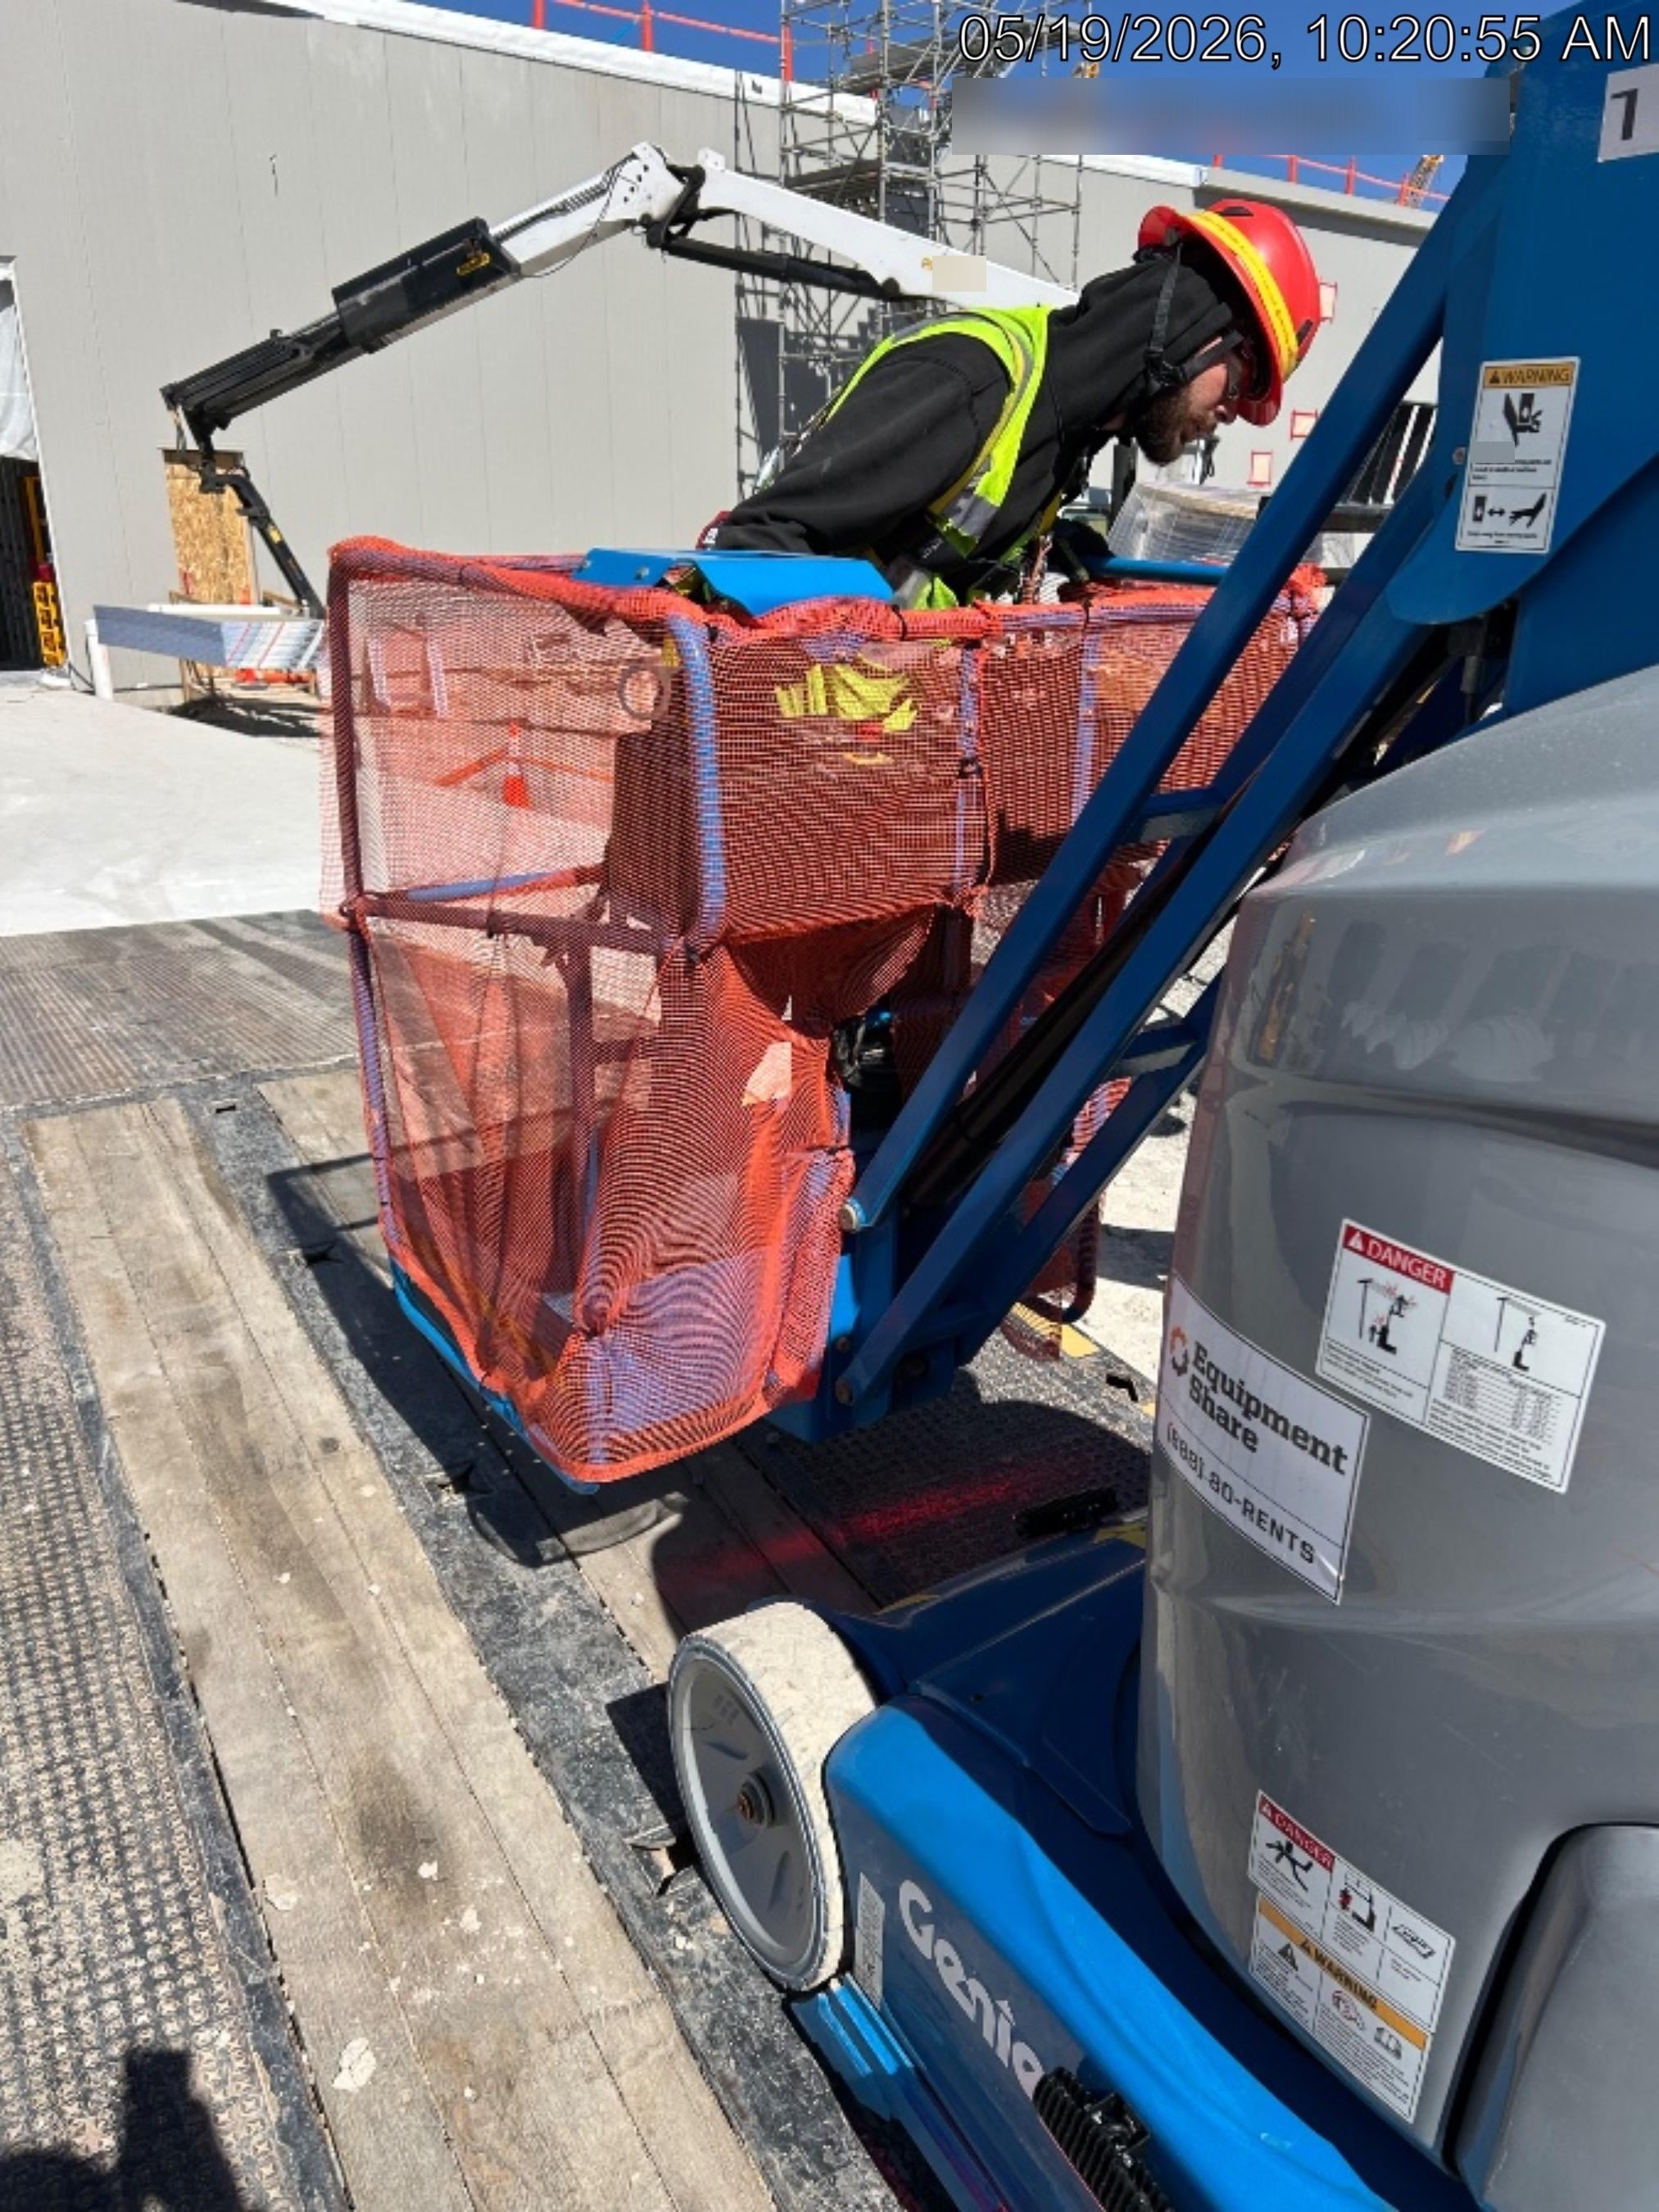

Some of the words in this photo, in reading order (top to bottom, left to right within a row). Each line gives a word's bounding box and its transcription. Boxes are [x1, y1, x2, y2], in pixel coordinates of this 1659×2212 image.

[1502, 368, 1570, 384] WARNING
[1367, 1238, 1447, 1290] DANGER
[1190, 1375, 1259, 1453] Share
[1192, 1341, 1349, 1475] Equipment
[1274, 1811, 1332, 1866] DANGER
[1315, 1947, 1378, 2010] WARNING
